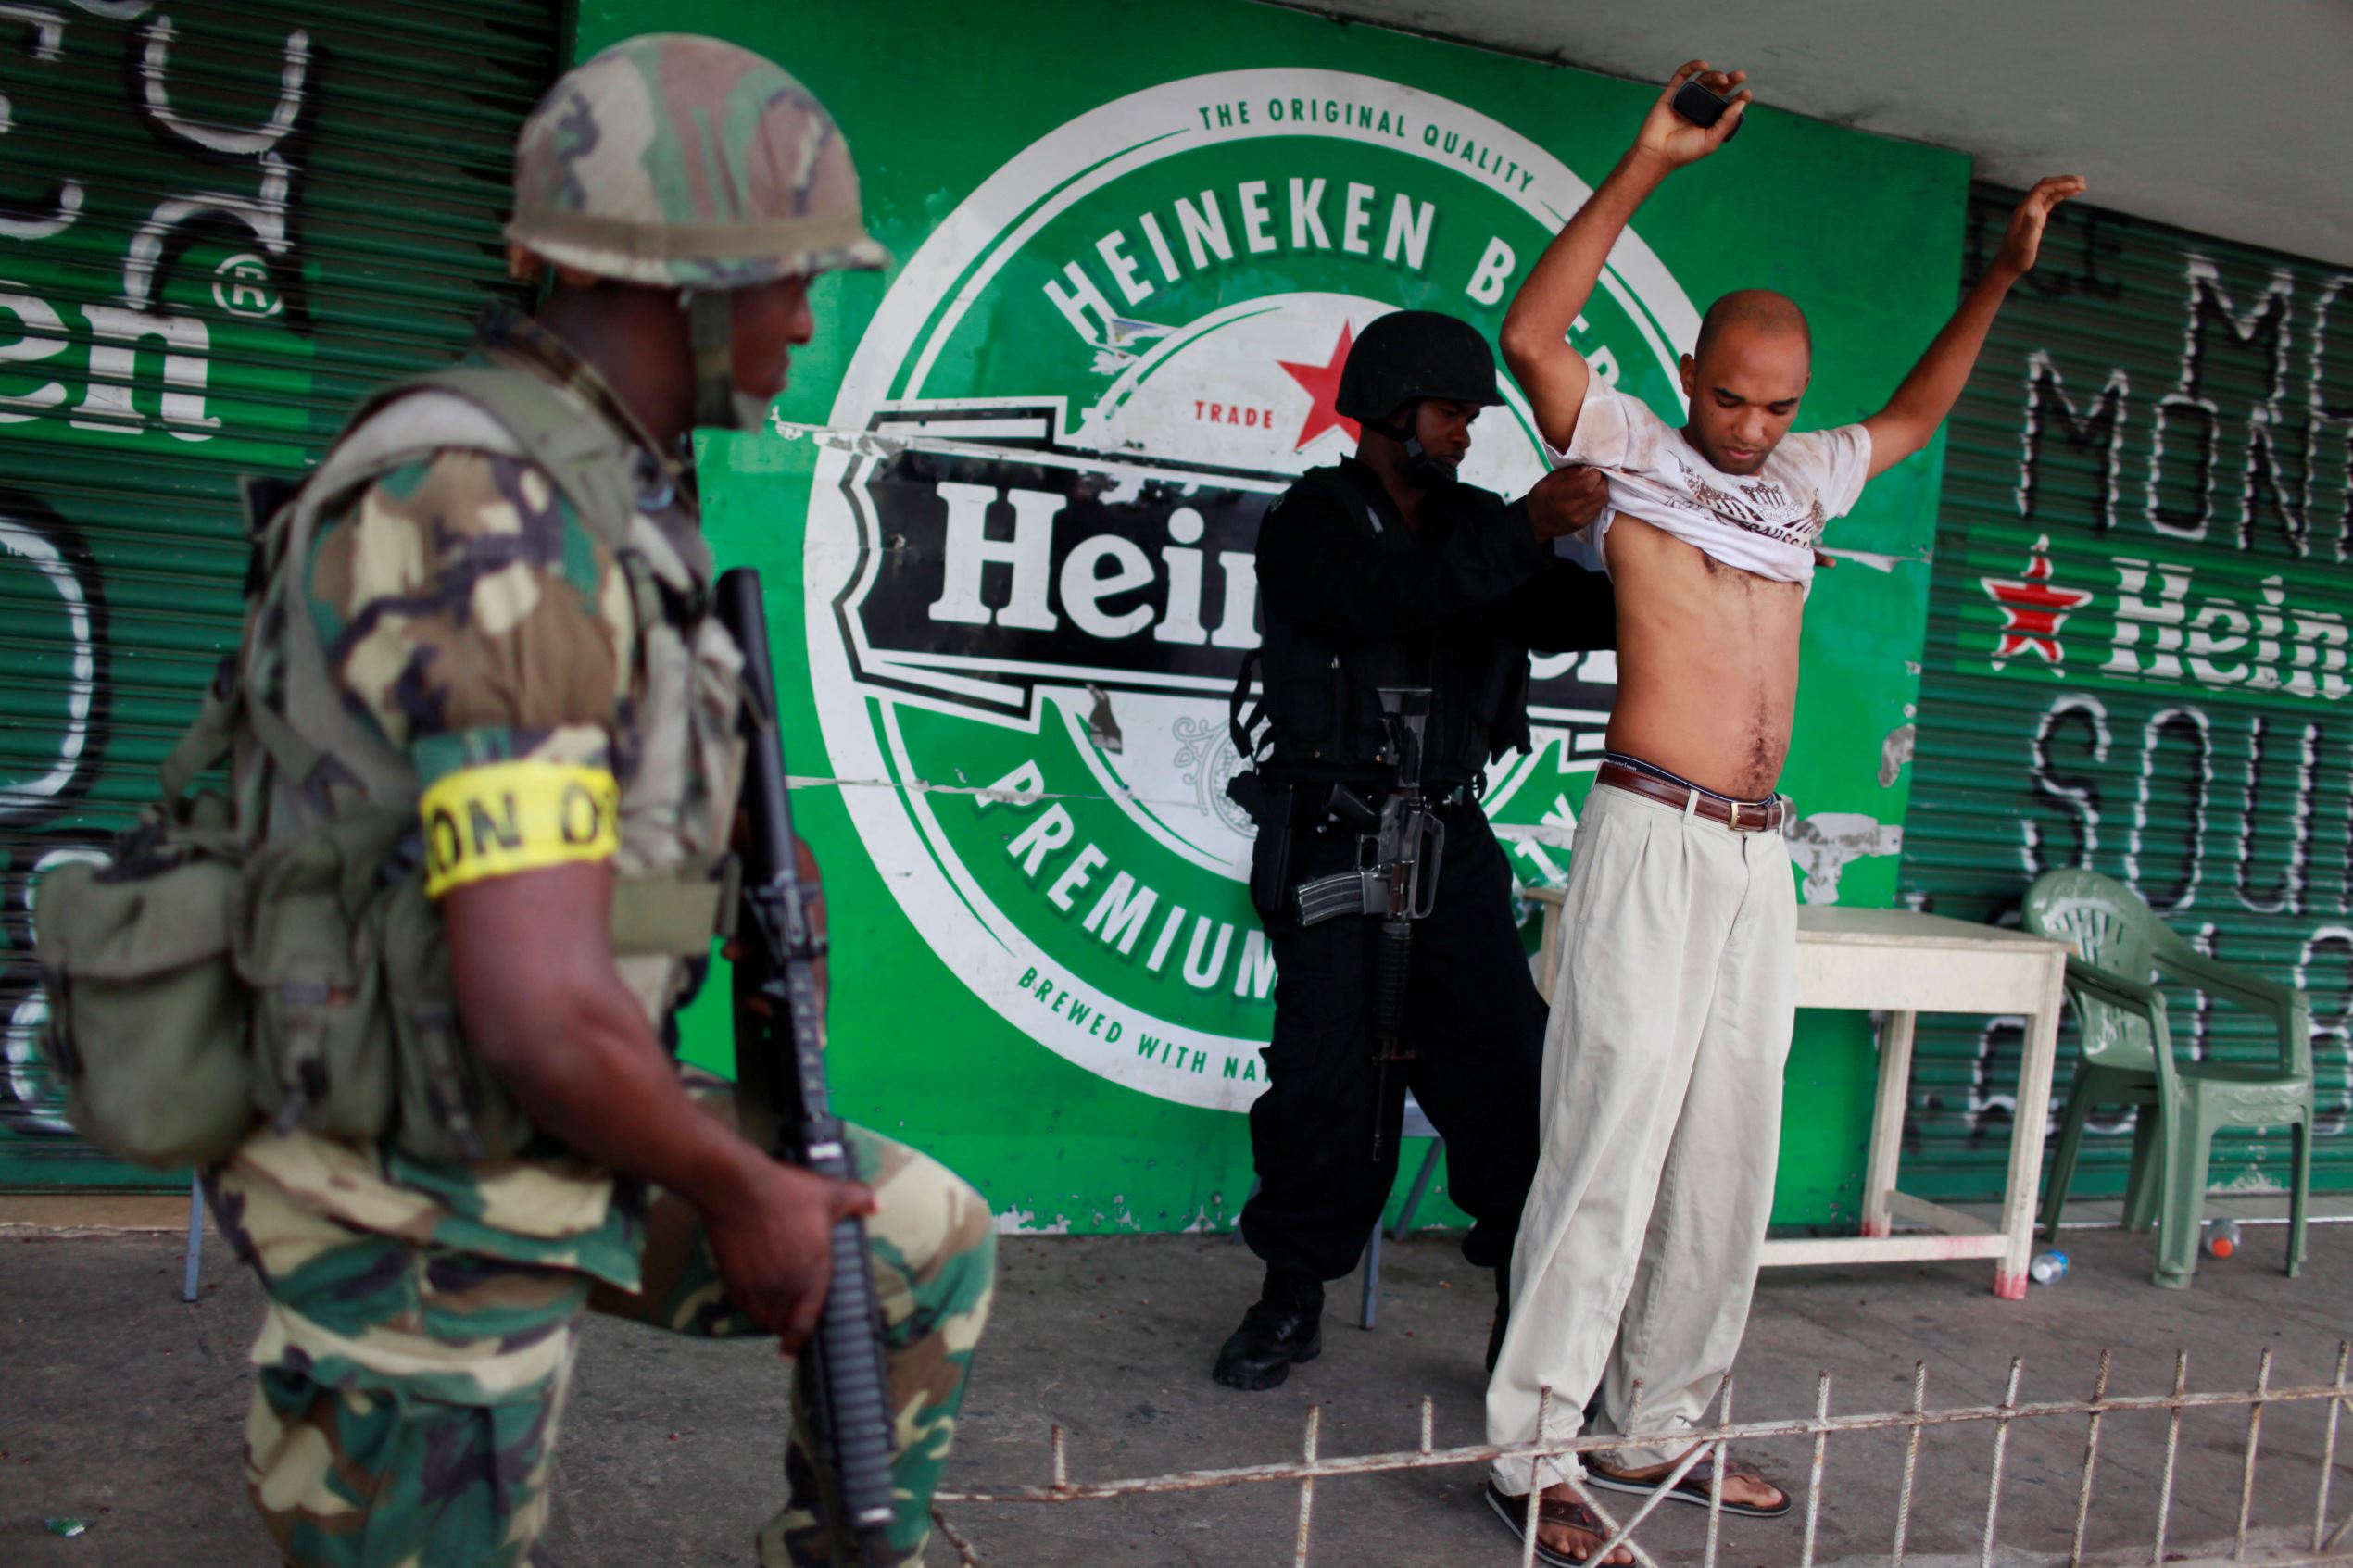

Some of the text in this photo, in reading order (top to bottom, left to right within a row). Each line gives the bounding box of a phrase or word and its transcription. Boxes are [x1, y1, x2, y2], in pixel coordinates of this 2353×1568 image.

[1199, 98, 1534, 192] THE ORIGINAL QUALITY
[1043, 179, 1435, 345] HEINEKEN
[1194, 400, 1274, 429] TRADE
[974, 759, 1278, 999] PREMIUM
[1018, 967, 1123, 1043] BREWED
[1137, 1034, 1207, 1074] WITH
